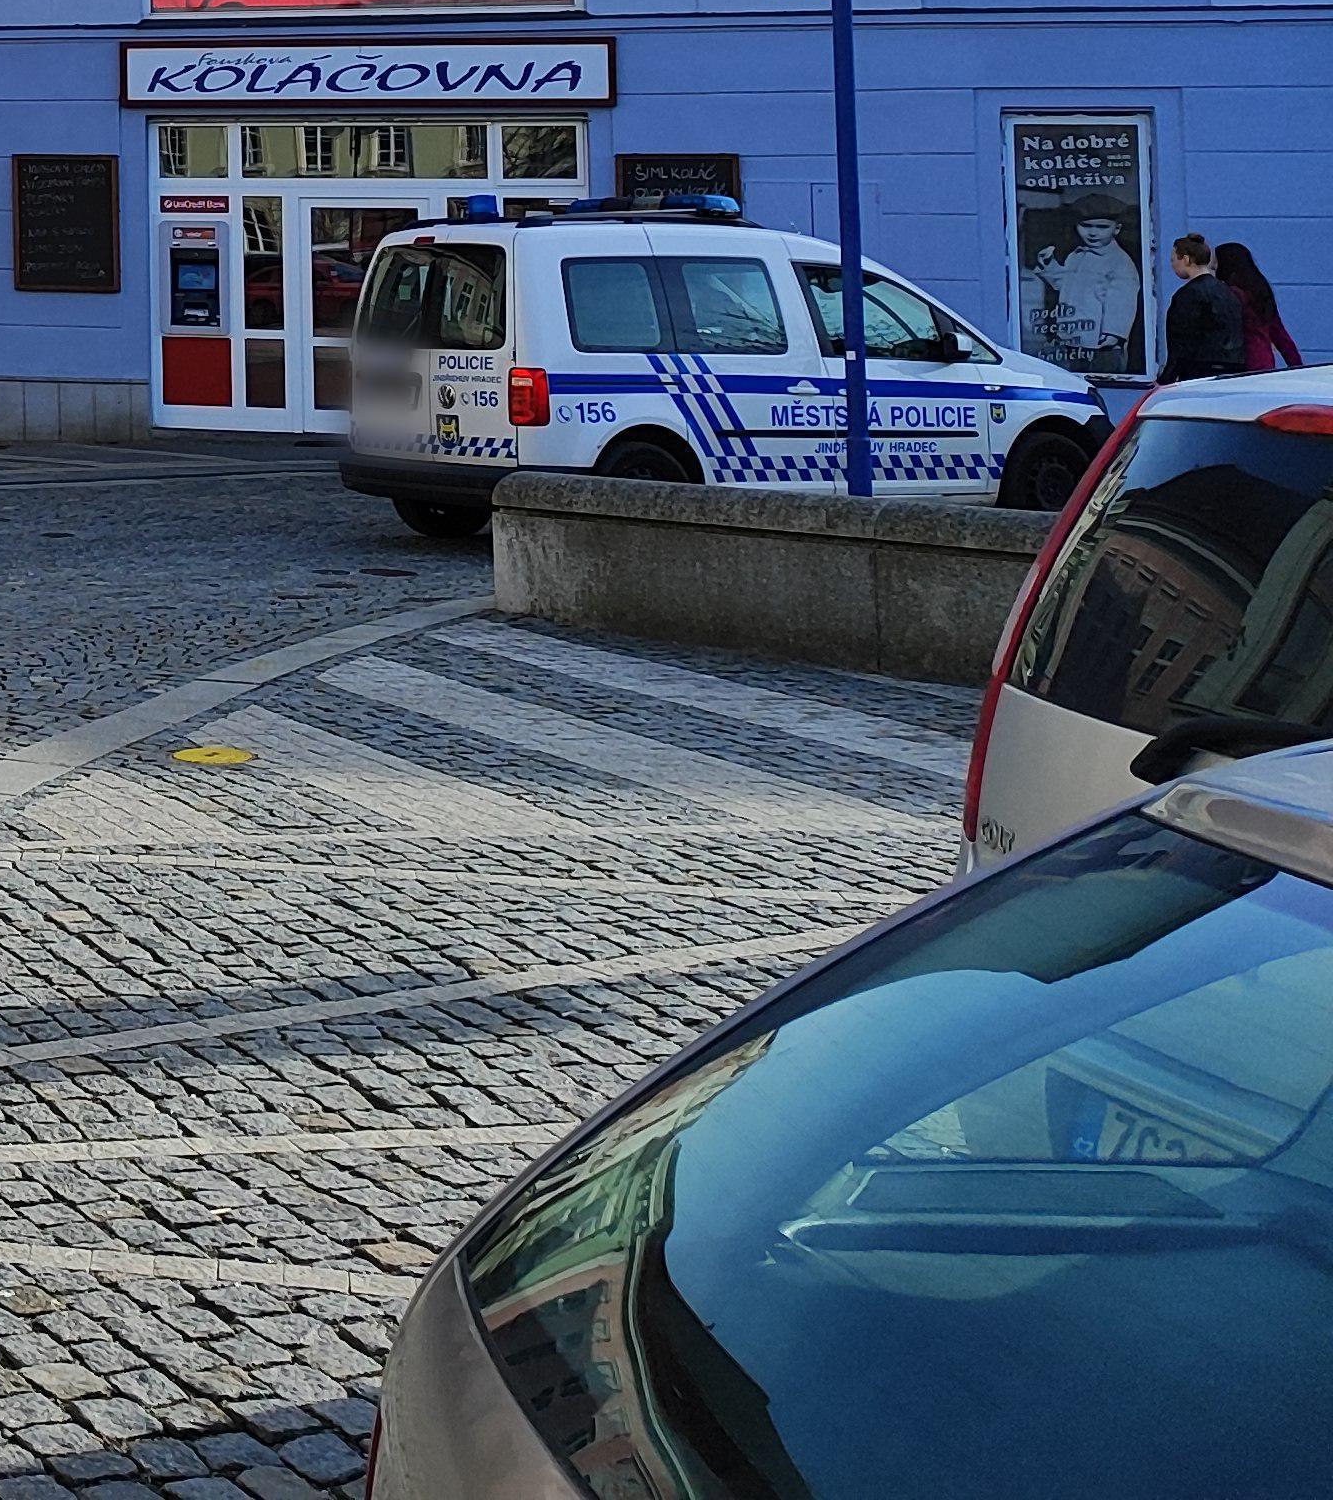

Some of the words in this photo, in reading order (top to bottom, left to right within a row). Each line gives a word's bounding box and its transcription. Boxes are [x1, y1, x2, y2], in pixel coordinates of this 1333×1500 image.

[146, 54, 583, 95] KOLÁČOVNA
[1022, 136, 1054, 151] Na
[1060, 133, 1130, 150] dobré
[1024, 154, 1102, 170] koláče
[1025, 173, 1126, 190] odjakživa
[1031, 303, 1074, 321] podle
[438, 355, 494, 371] POLICIE
[471, 390, 499, 408] 156
[575, 401, 617, 424] 156
[771, 400, 883, 428] MĚSTSÁ
[890, 406, 977, 428] POLICIE
[889, 441, 938, 454] HRADEC
